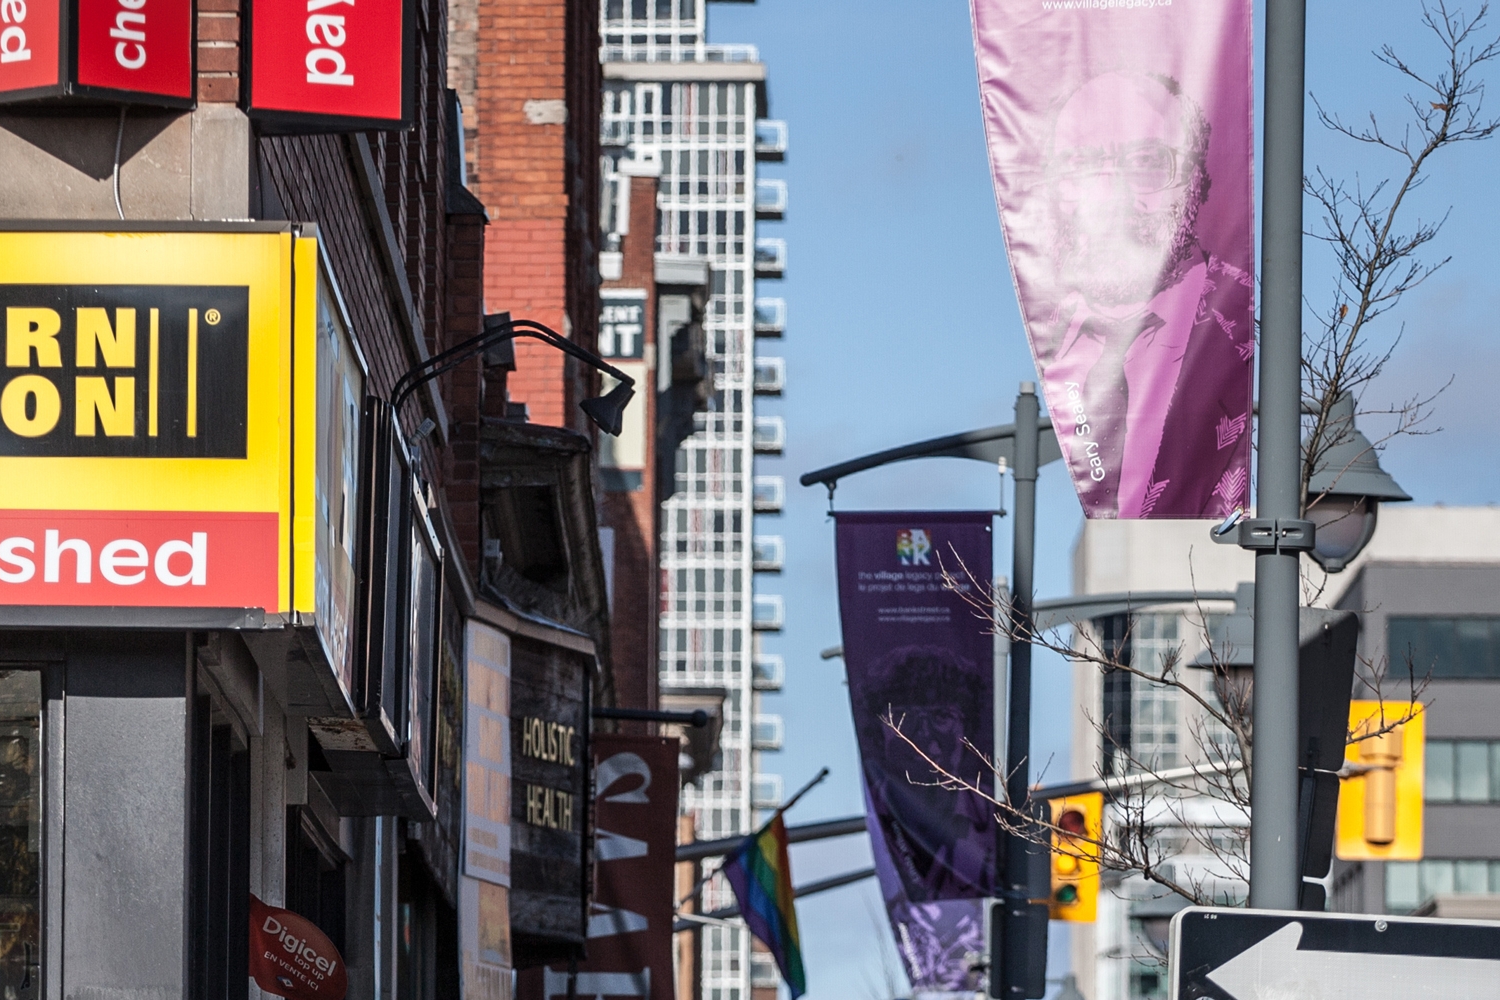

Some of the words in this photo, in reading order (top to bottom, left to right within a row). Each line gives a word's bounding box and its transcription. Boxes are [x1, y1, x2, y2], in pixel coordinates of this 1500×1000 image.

[1065, 382, 1091, 436] Sealey
[1084, 442, 1105, 482] Gary
[522, 716, 575, 767] HOLISTIC
[526, 783, 574, 832] HEALTH
[262, 916, 337, 977] Digicel
[263, 951, 278, 963] EN
[279, 959, 307, 982] VENTE
[307, 979, 319, 991] ICI
[294, 954, 310, 971] top
[311, 968, 325, 981] up
